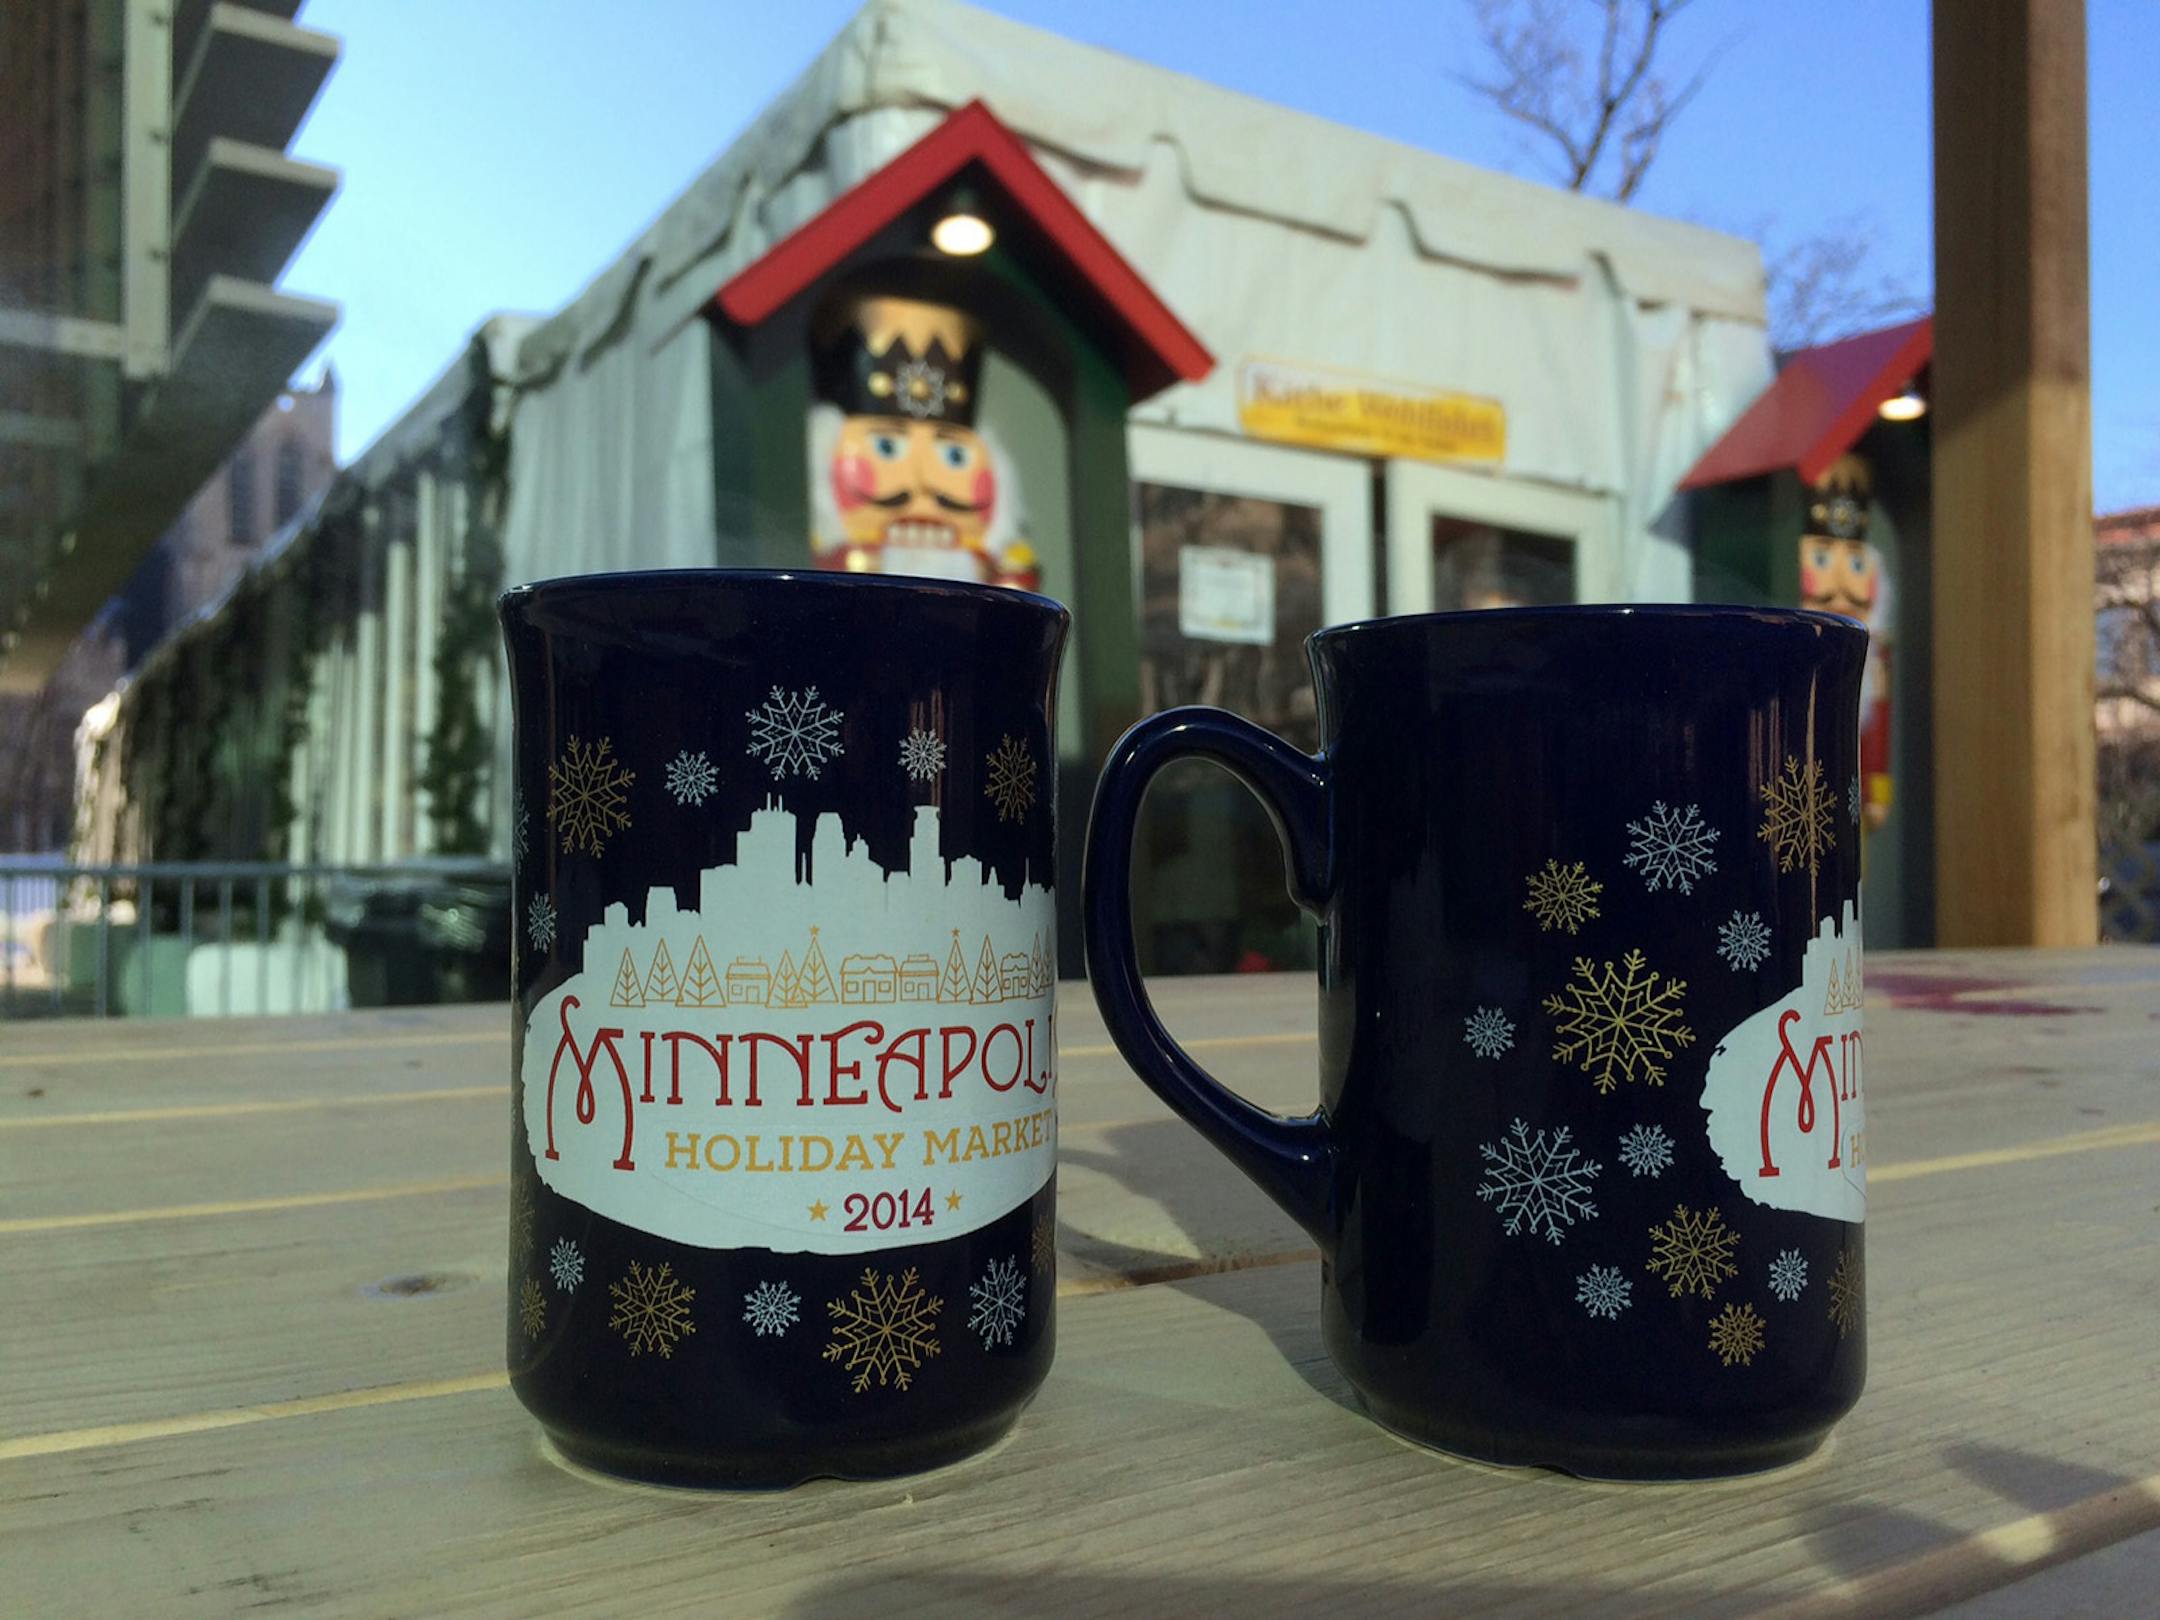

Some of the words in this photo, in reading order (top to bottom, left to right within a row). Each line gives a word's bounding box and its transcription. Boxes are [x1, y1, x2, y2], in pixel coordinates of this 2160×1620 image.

[664, 1131, 905, 1173] HOLIDAY
[923, 1108, 1053, 1166] MARKET
[843, 1187, 935, 1232] 2014
